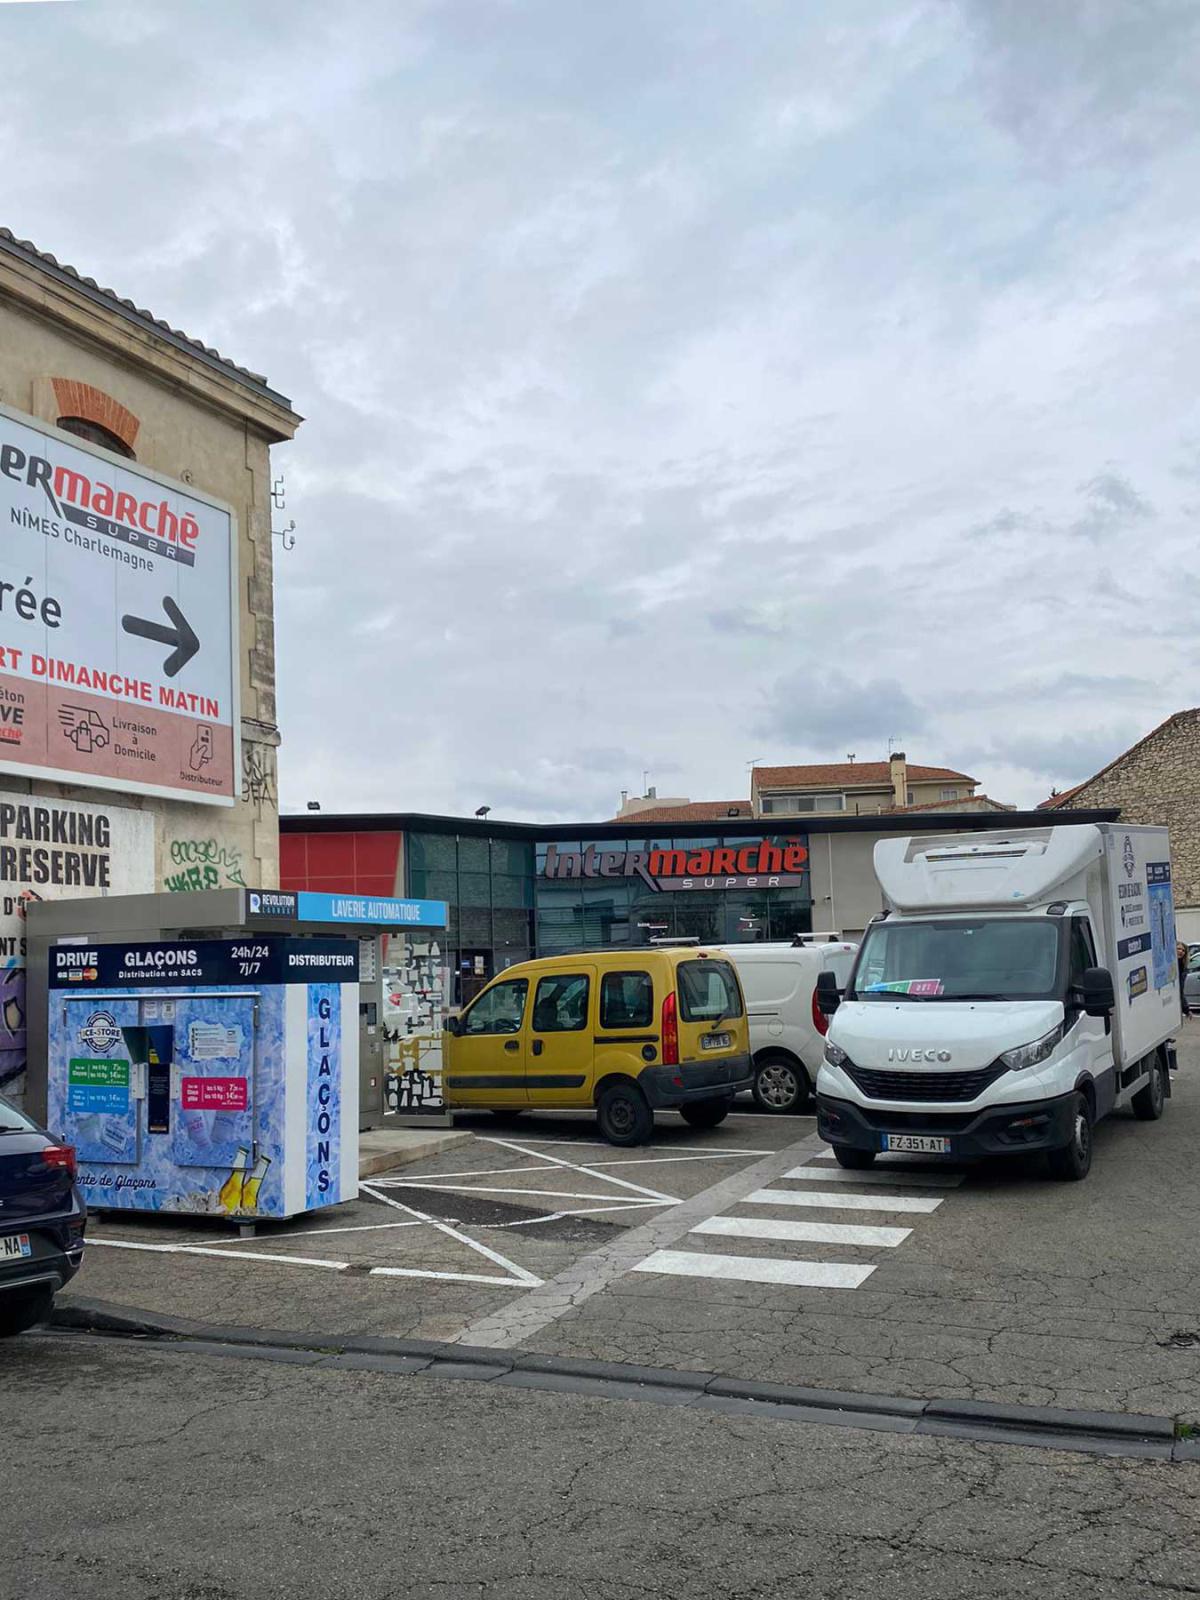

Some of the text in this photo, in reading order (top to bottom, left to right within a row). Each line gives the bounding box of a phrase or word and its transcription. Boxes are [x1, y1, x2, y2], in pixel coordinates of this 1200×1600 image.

[10, 506, 154, 572] NÎMES Charlemagne
[31, 654, 152, 702] DIMANCHE
[159, 685, 219, 718] MATIN
[112, 717, 157, 736] Livraison
[114, 744, 156, 761] Domicile
[180, 771, 223, 786] Distributeur
[0, 803, 110, 848] PARKING
[262, 894, 295, 906] REVOLUTION
[332, 899, 421, 921] LAVERIE AUTOMATIQUE
[56, 946, 269, 969] DRIVE GLAÇONS 24h/24
[288, 954, 354, 966] DISTRIBUTEUR
[118, 970, 166, 979] Distribution
[180, 969, 203, 977] SACS
[239, 962, 261, 976] 7j/7
[888, 1048, 952, 1062] IVECO
[317, 998, 330, 1192] GLAÇONS
[889, 1136, 942, 1151] FZ-351-AT
[99, 1174, 113, 1186] de
[115, 1175, 157, 1191] Glaçons
